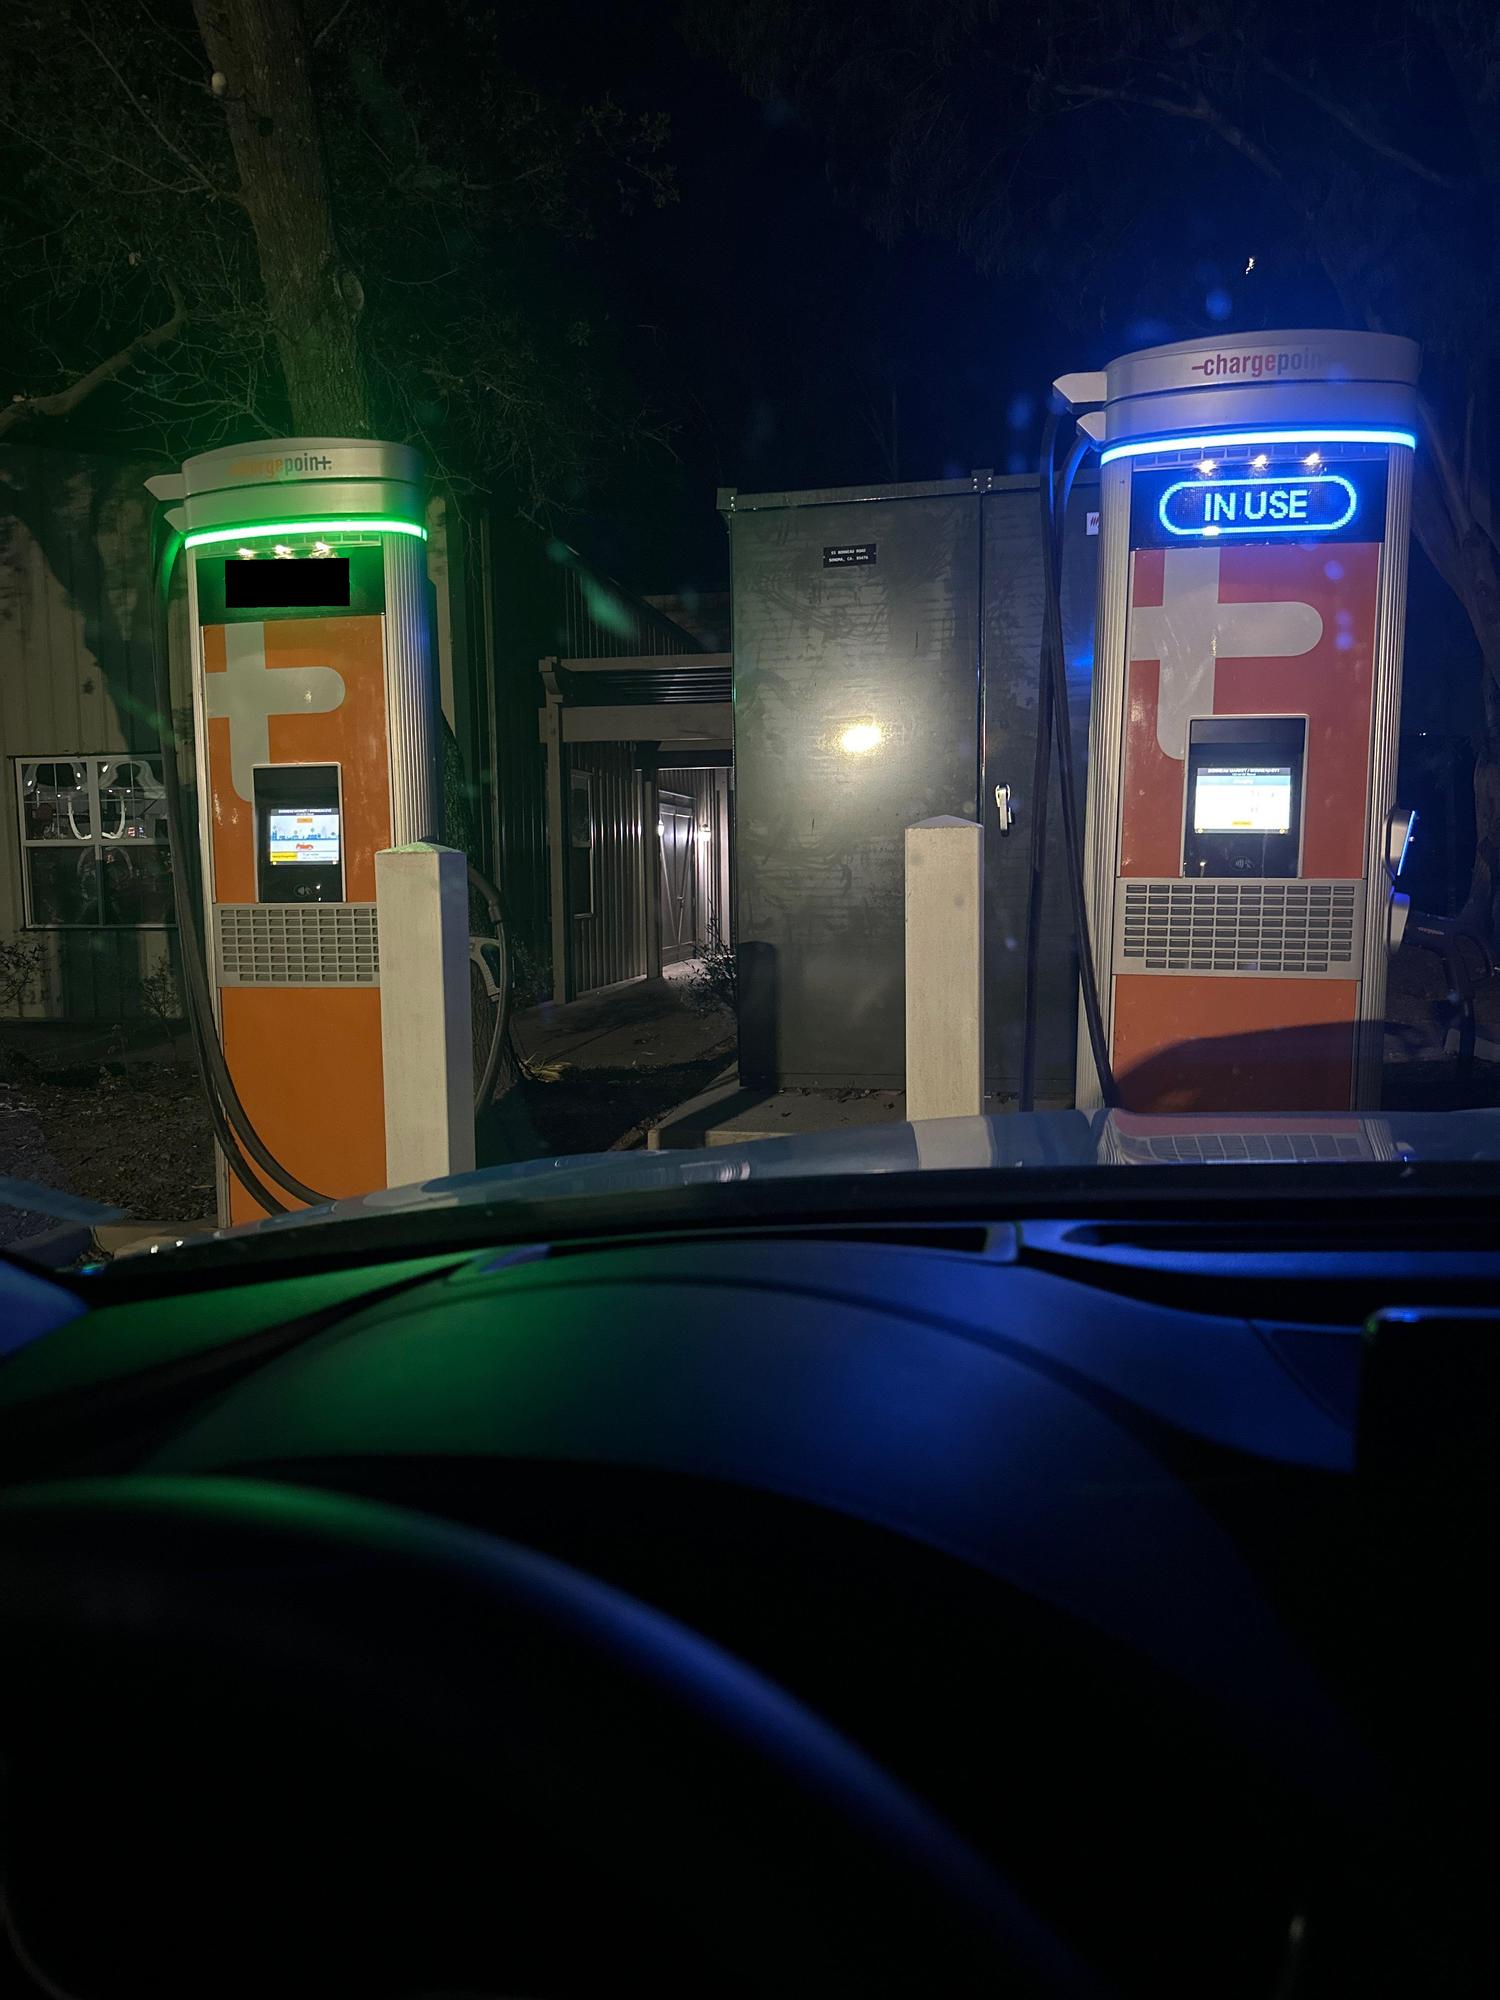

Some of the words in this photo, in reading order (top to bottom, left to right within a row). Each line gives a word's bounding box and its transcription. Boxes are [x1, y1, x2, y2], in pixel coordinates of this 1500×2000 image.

[1192, 347, 1323, 378] chargepoin
[1204, 492, 1236, 521] IN
[1244, 489, 1308, 519] USE
